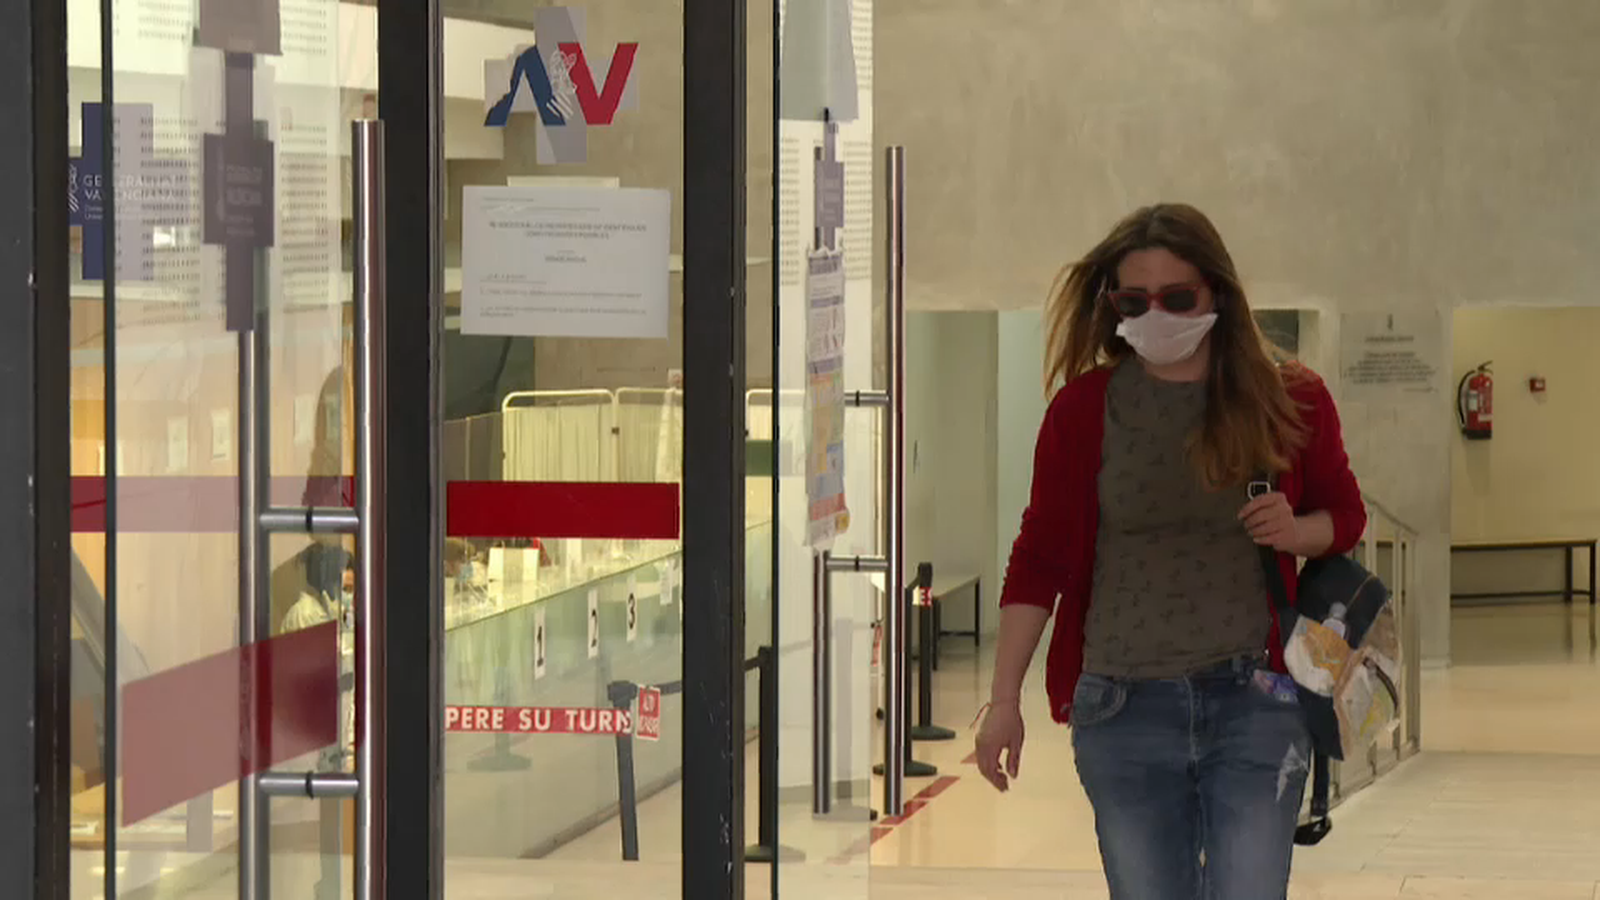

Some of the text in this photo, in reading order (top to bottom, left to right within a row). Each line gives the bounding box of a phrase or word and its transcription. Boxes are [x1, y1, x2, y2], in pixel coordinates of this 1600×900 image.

[591, 609, 598, 648] 2
[628, 593, 636, 630] 3
[537, 626, 544, 667] 1
[519, 708, 551, 732] SU
